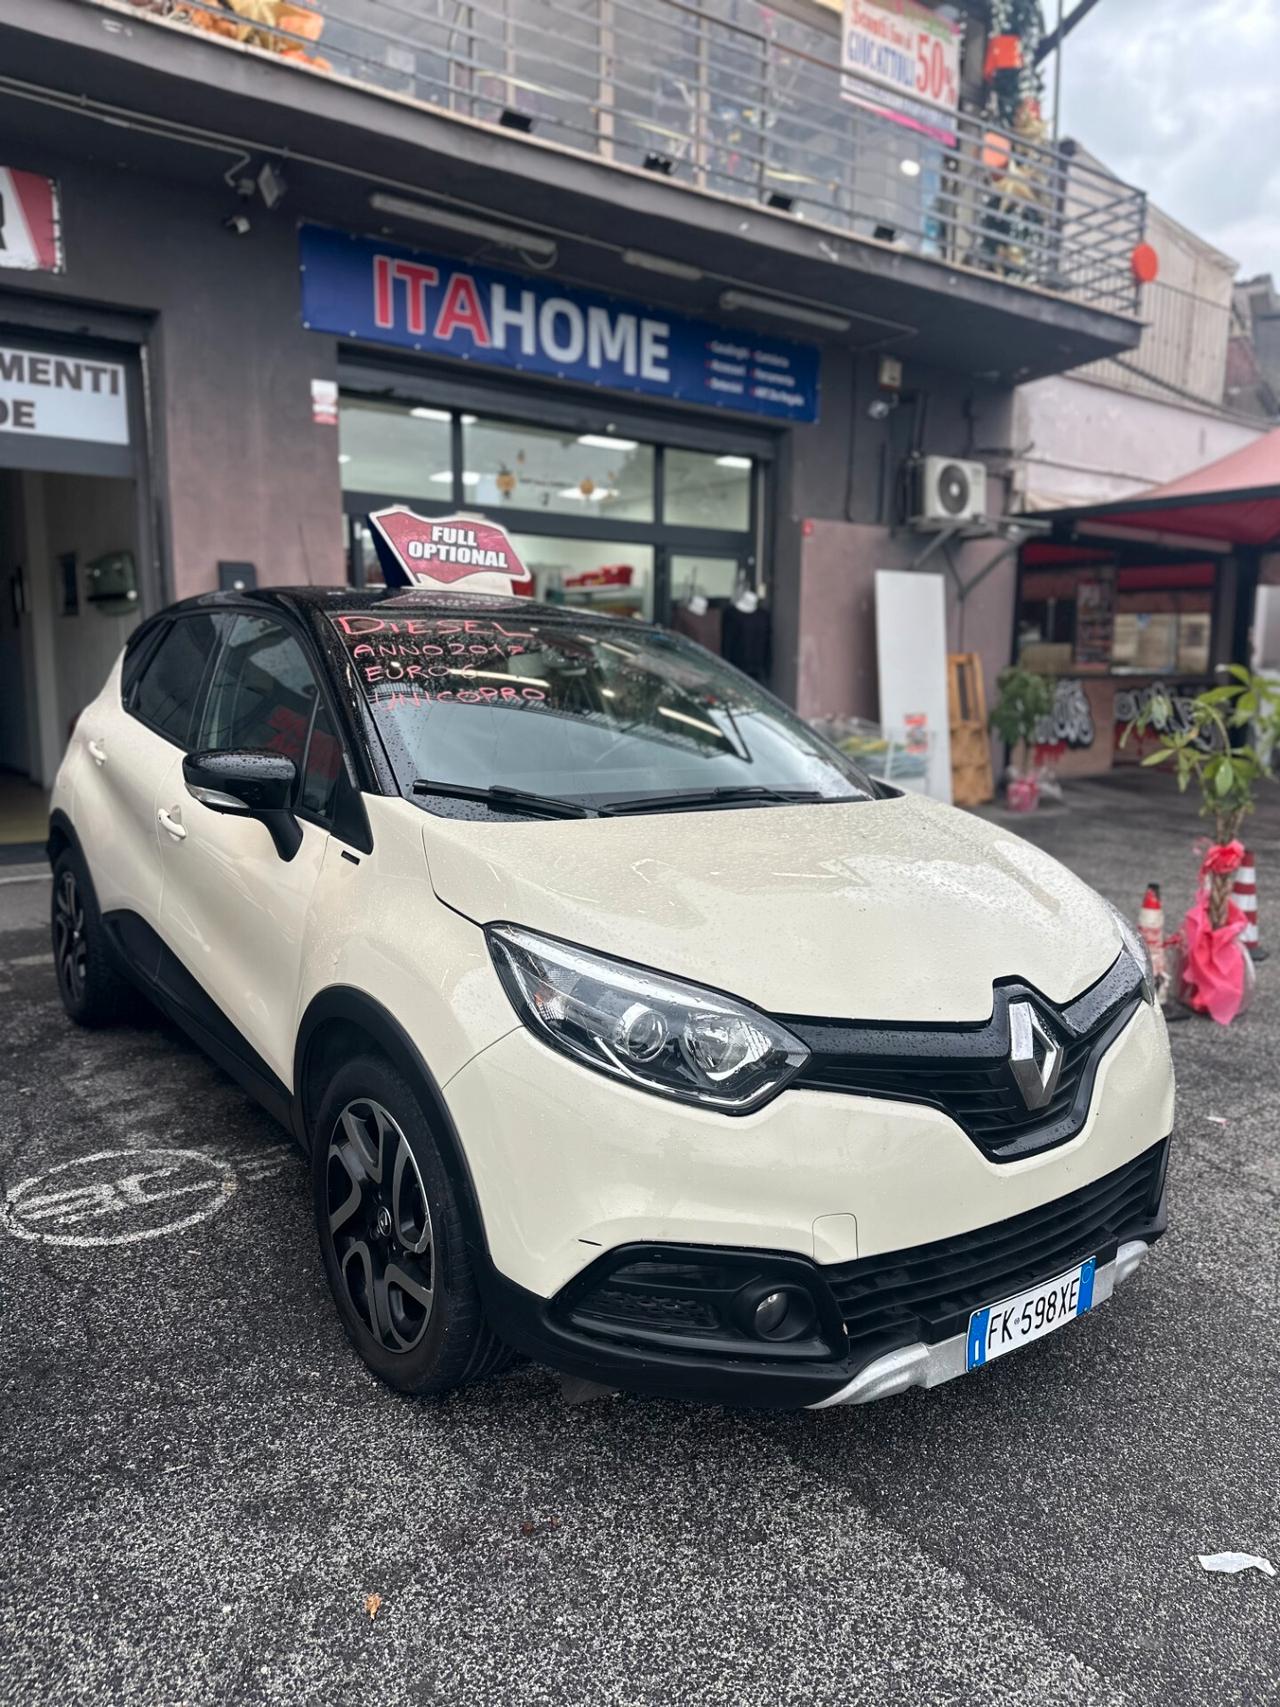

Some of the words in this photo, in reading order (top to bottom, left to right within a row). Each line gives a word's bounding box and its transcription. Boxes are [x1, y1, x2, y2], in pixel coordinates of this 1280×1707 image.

[372, 254, 670, 383] ITAHOME
[431, 525, 477, 547] FULL
[408, 540, 508, 569] OPTIONAL
[338, 616, 535, 639] DIESEL
[353, 644, 443, 659] ANNO
[365, 665, 450, 683] EURO
